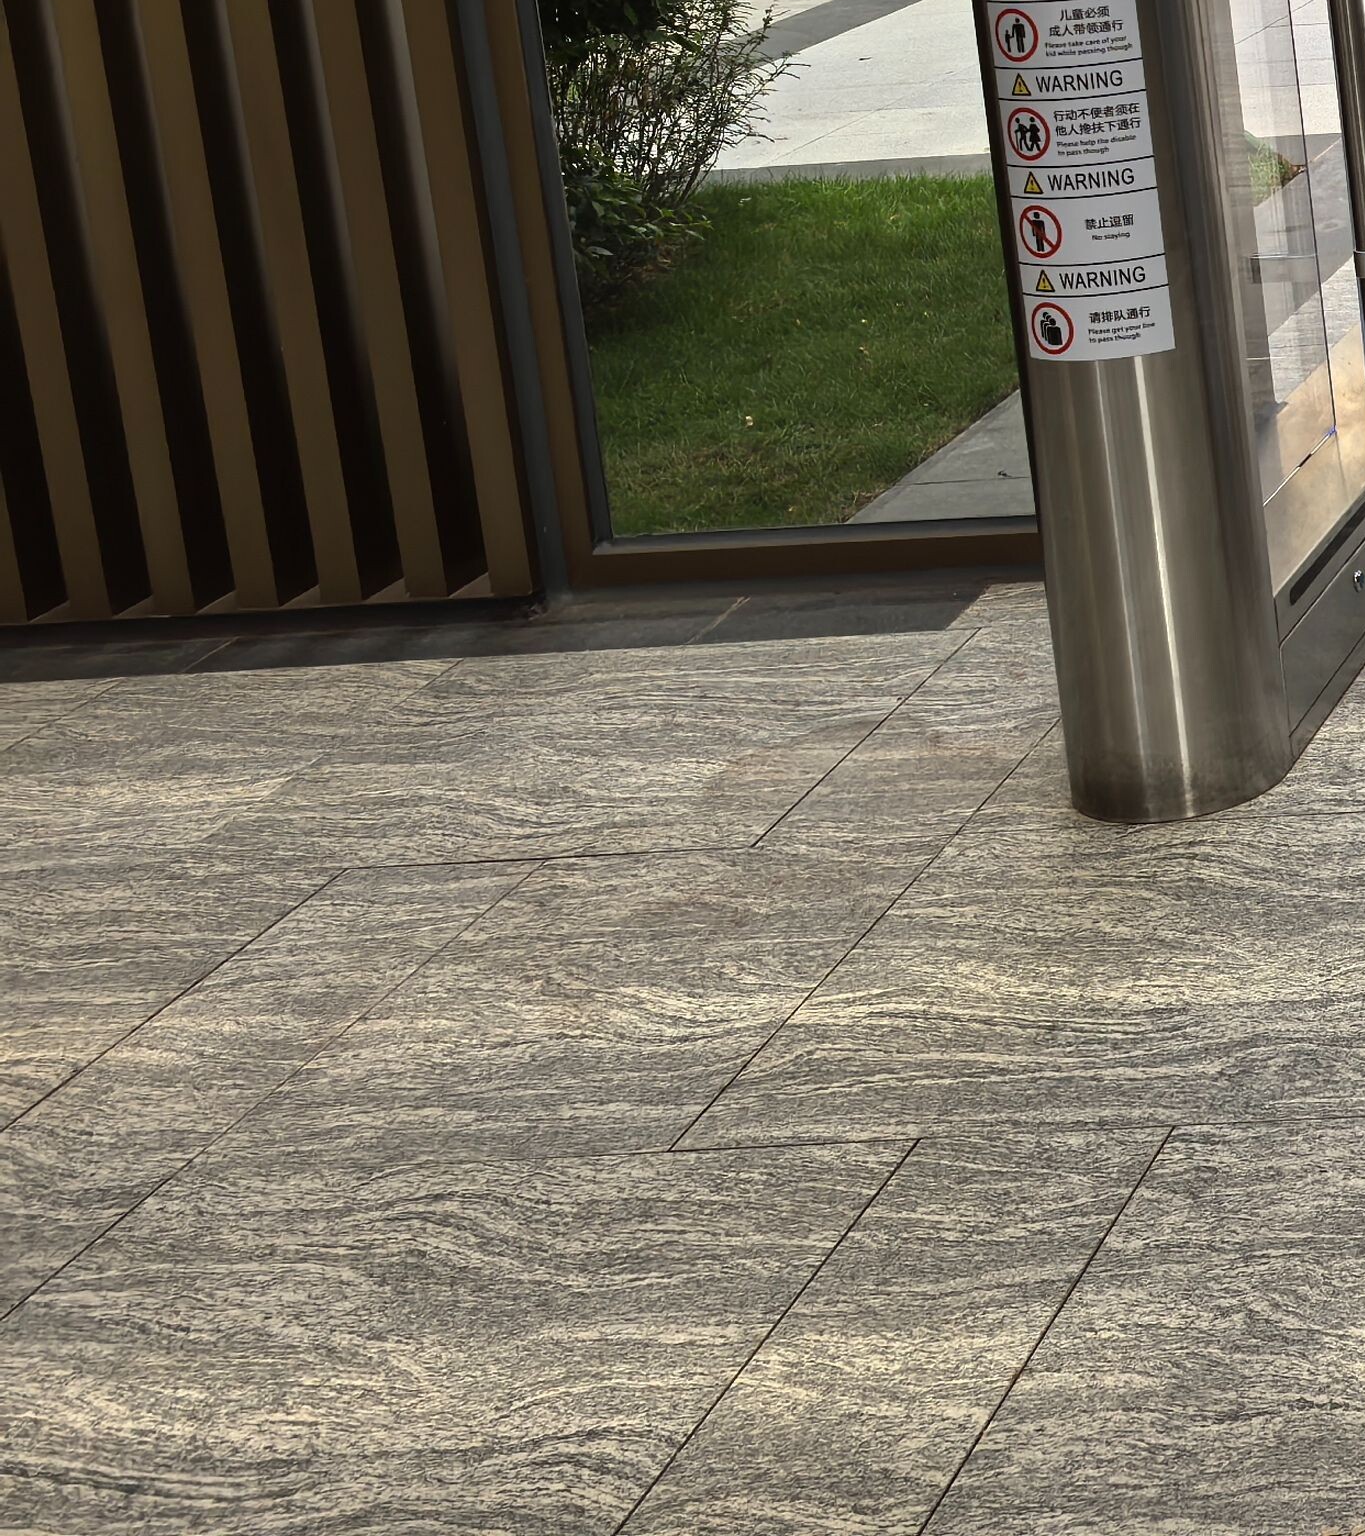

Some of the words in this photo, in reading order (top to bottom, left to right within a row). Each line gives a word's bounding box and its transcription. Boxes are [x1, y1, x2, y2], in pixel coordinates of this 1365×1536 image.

[1060, 5, 1110, 21] 儿童必须
[1035, 70, 1123, 93] WARNING
[1047, 168, 1135, 191] WARNING
[1059, 266, 1146, 289] WARNING
[1089, 306, 1151, 324] 请排队通行
